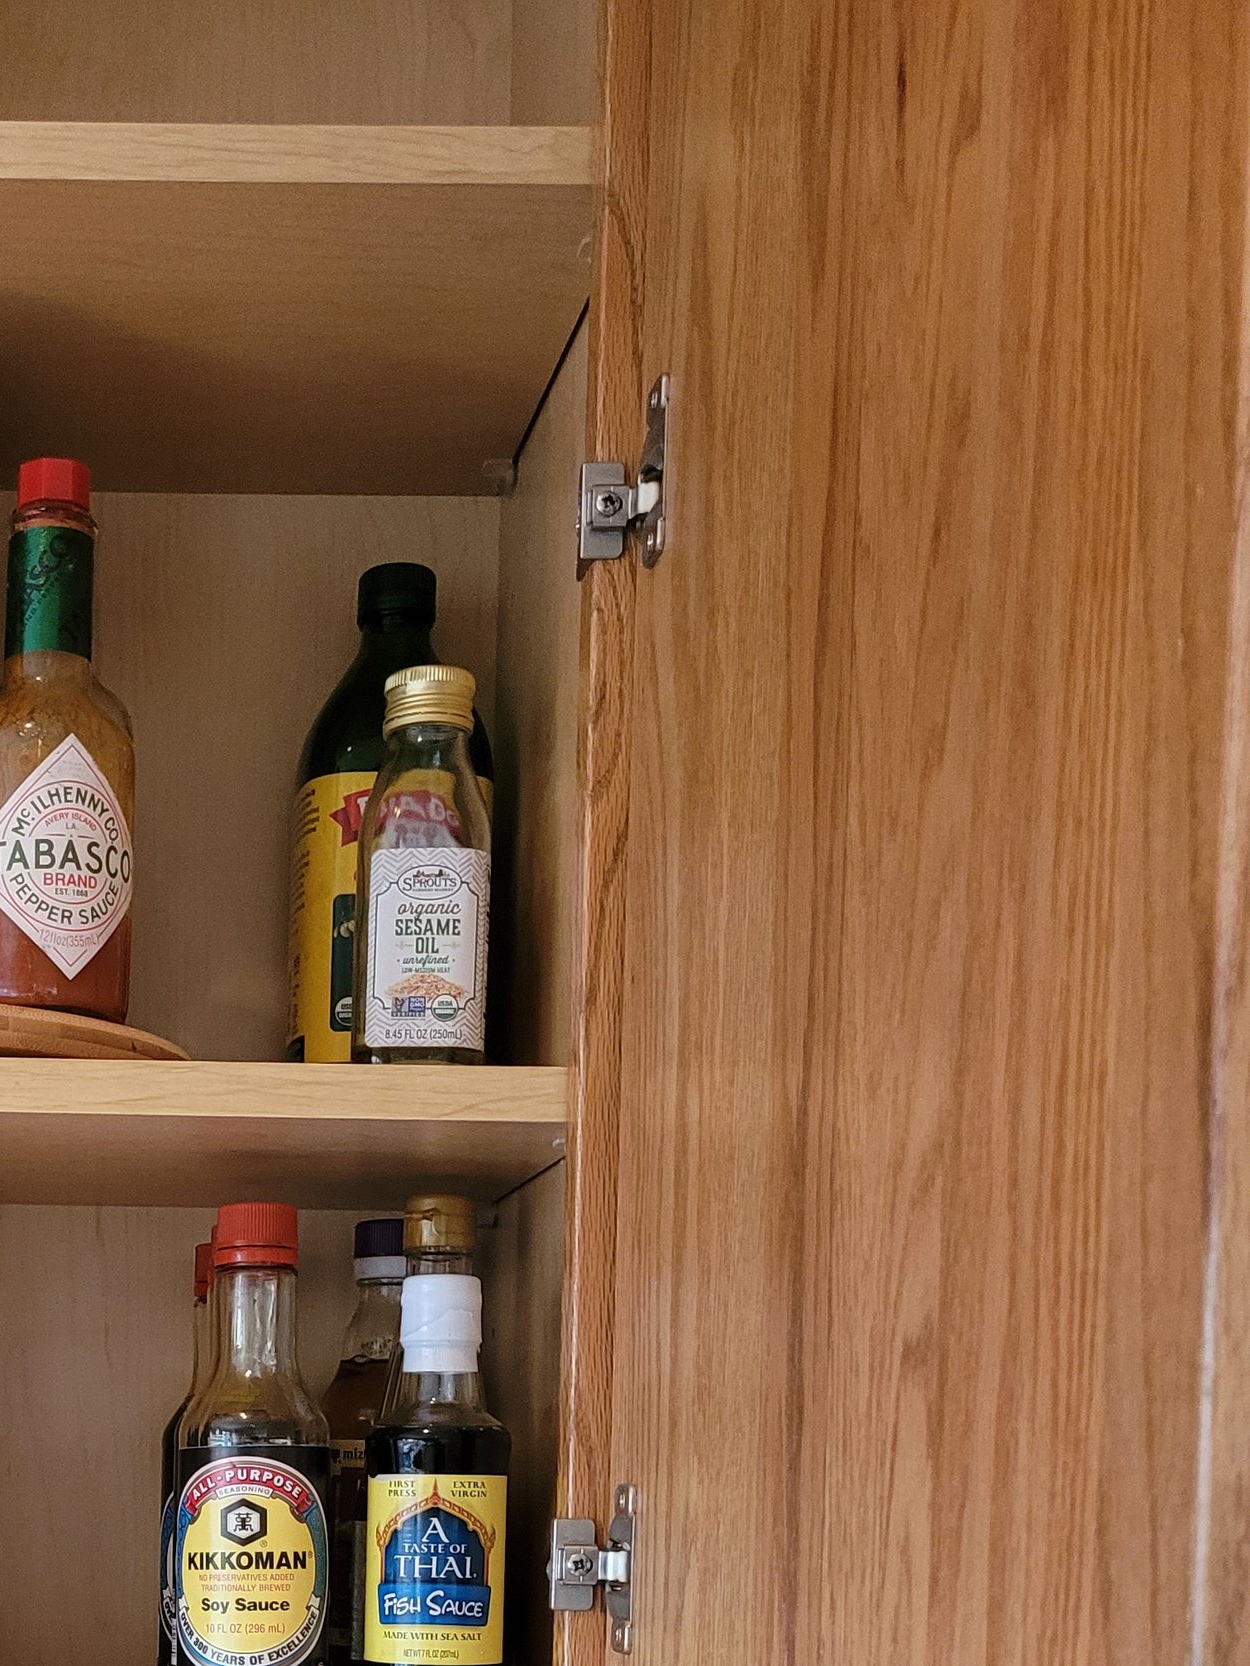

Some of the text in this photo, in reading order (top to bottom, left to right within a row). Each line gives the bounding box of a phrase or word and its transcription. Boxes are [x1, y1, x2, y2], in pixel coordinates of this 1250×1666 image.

[44, 812, 97, 831] AVERY ISLAND
[43, 872, 97, 889] BRAND
[402, 878, 457, 892] SPROUTS
[9, 872, 119, 925] PEPPER SAUCE
[54, 887, 89, 898] EST. 1868
[398, 900, 461, 920] organic
[395, 919, 461, 936] SESAME
[415, 937, 439, 954] OIL
[402, 954, 450, 968] unrefined
[385, 1029, 463, 1041] 8.45 FL OZ (250mL)
[193, 1468, 301, 1500] ALL-PURPOSE
[218, 1485, 271, 1496] SEASONING
[389, 1480, 487, 1489] FIRST EXTRA
[388, 1489, 488, 1498] PRESS VIRGIN
[421, 1517, 450, 1543] A
[403, 1543, 468, 1554] TASTE OF
[188, 1551, 307, 1571] KIKKOMAN
[209, 1573, 268, 1581] PRESERVATIVES
[269, 1573, 295, 1581] ADDED
[201, 1583, 291, 1592] TRADITIONALLY BREWED
[201, 1597, 290, 1614] Soy Sauce
[206, 1623, 286, 1635] 10 FL OZ (296 mL)
[383, 1631, 483, 1641] MADE WITH SEA SALT
[180, 1611, 318, 1666] OVER 300 YEARS OF EXCELLENCE
[403, 1648, 413, 1658] NET
